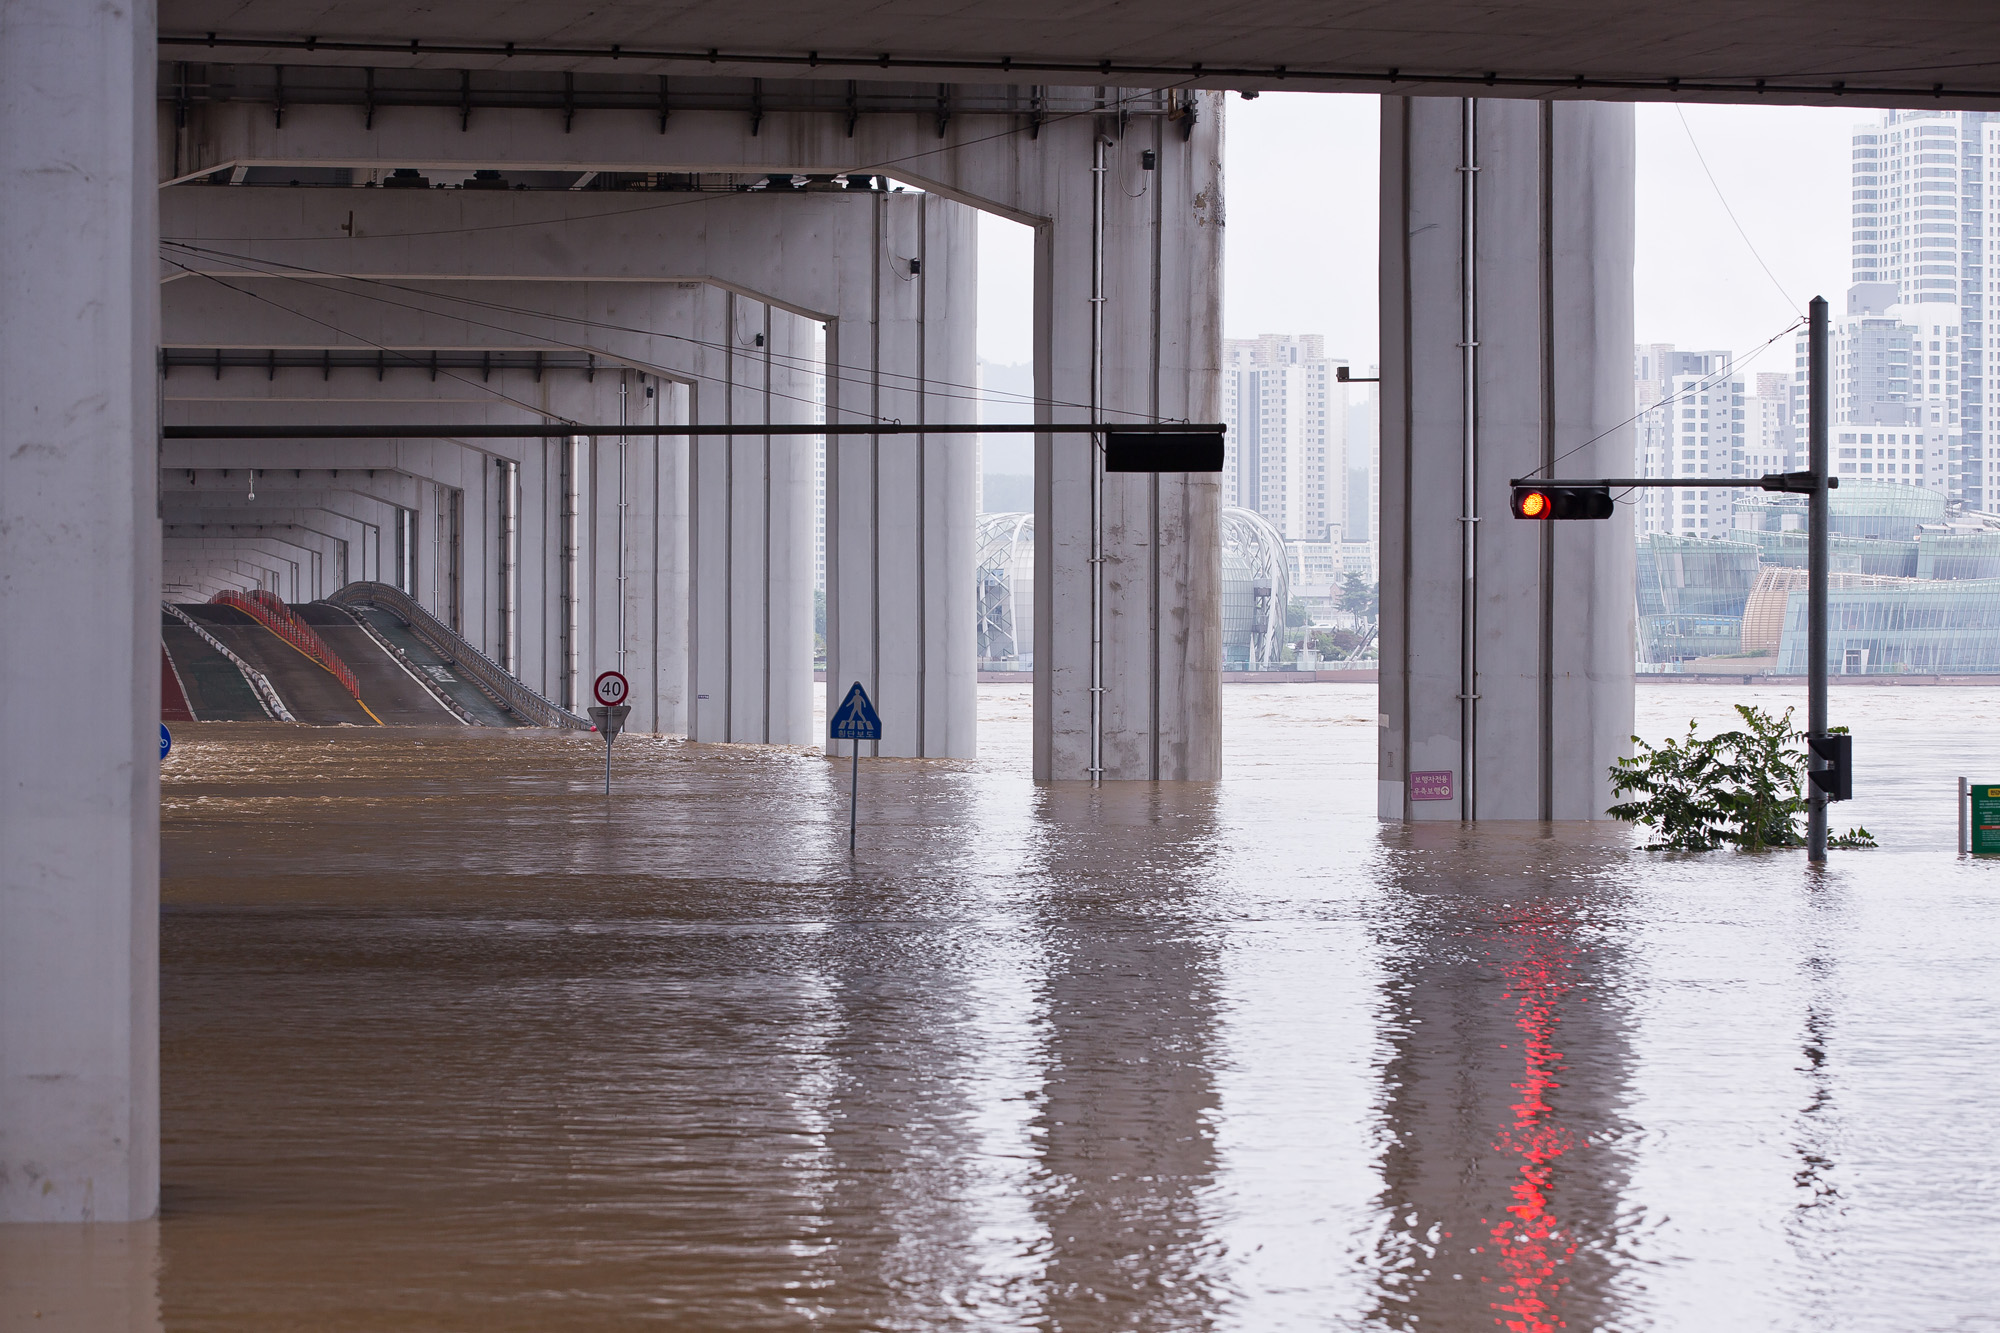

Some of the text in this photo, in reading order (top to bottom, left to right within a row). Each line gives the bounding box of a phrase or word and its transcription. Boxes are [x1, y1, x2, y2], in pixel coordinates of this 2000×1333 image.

[602, 682, 621, 696] 40
[838, 730, 874, 738] 횡단보도
[1415, 775, 1448, 784] 보행자전용
[1414, 786, 1441, 795] 우측보행
